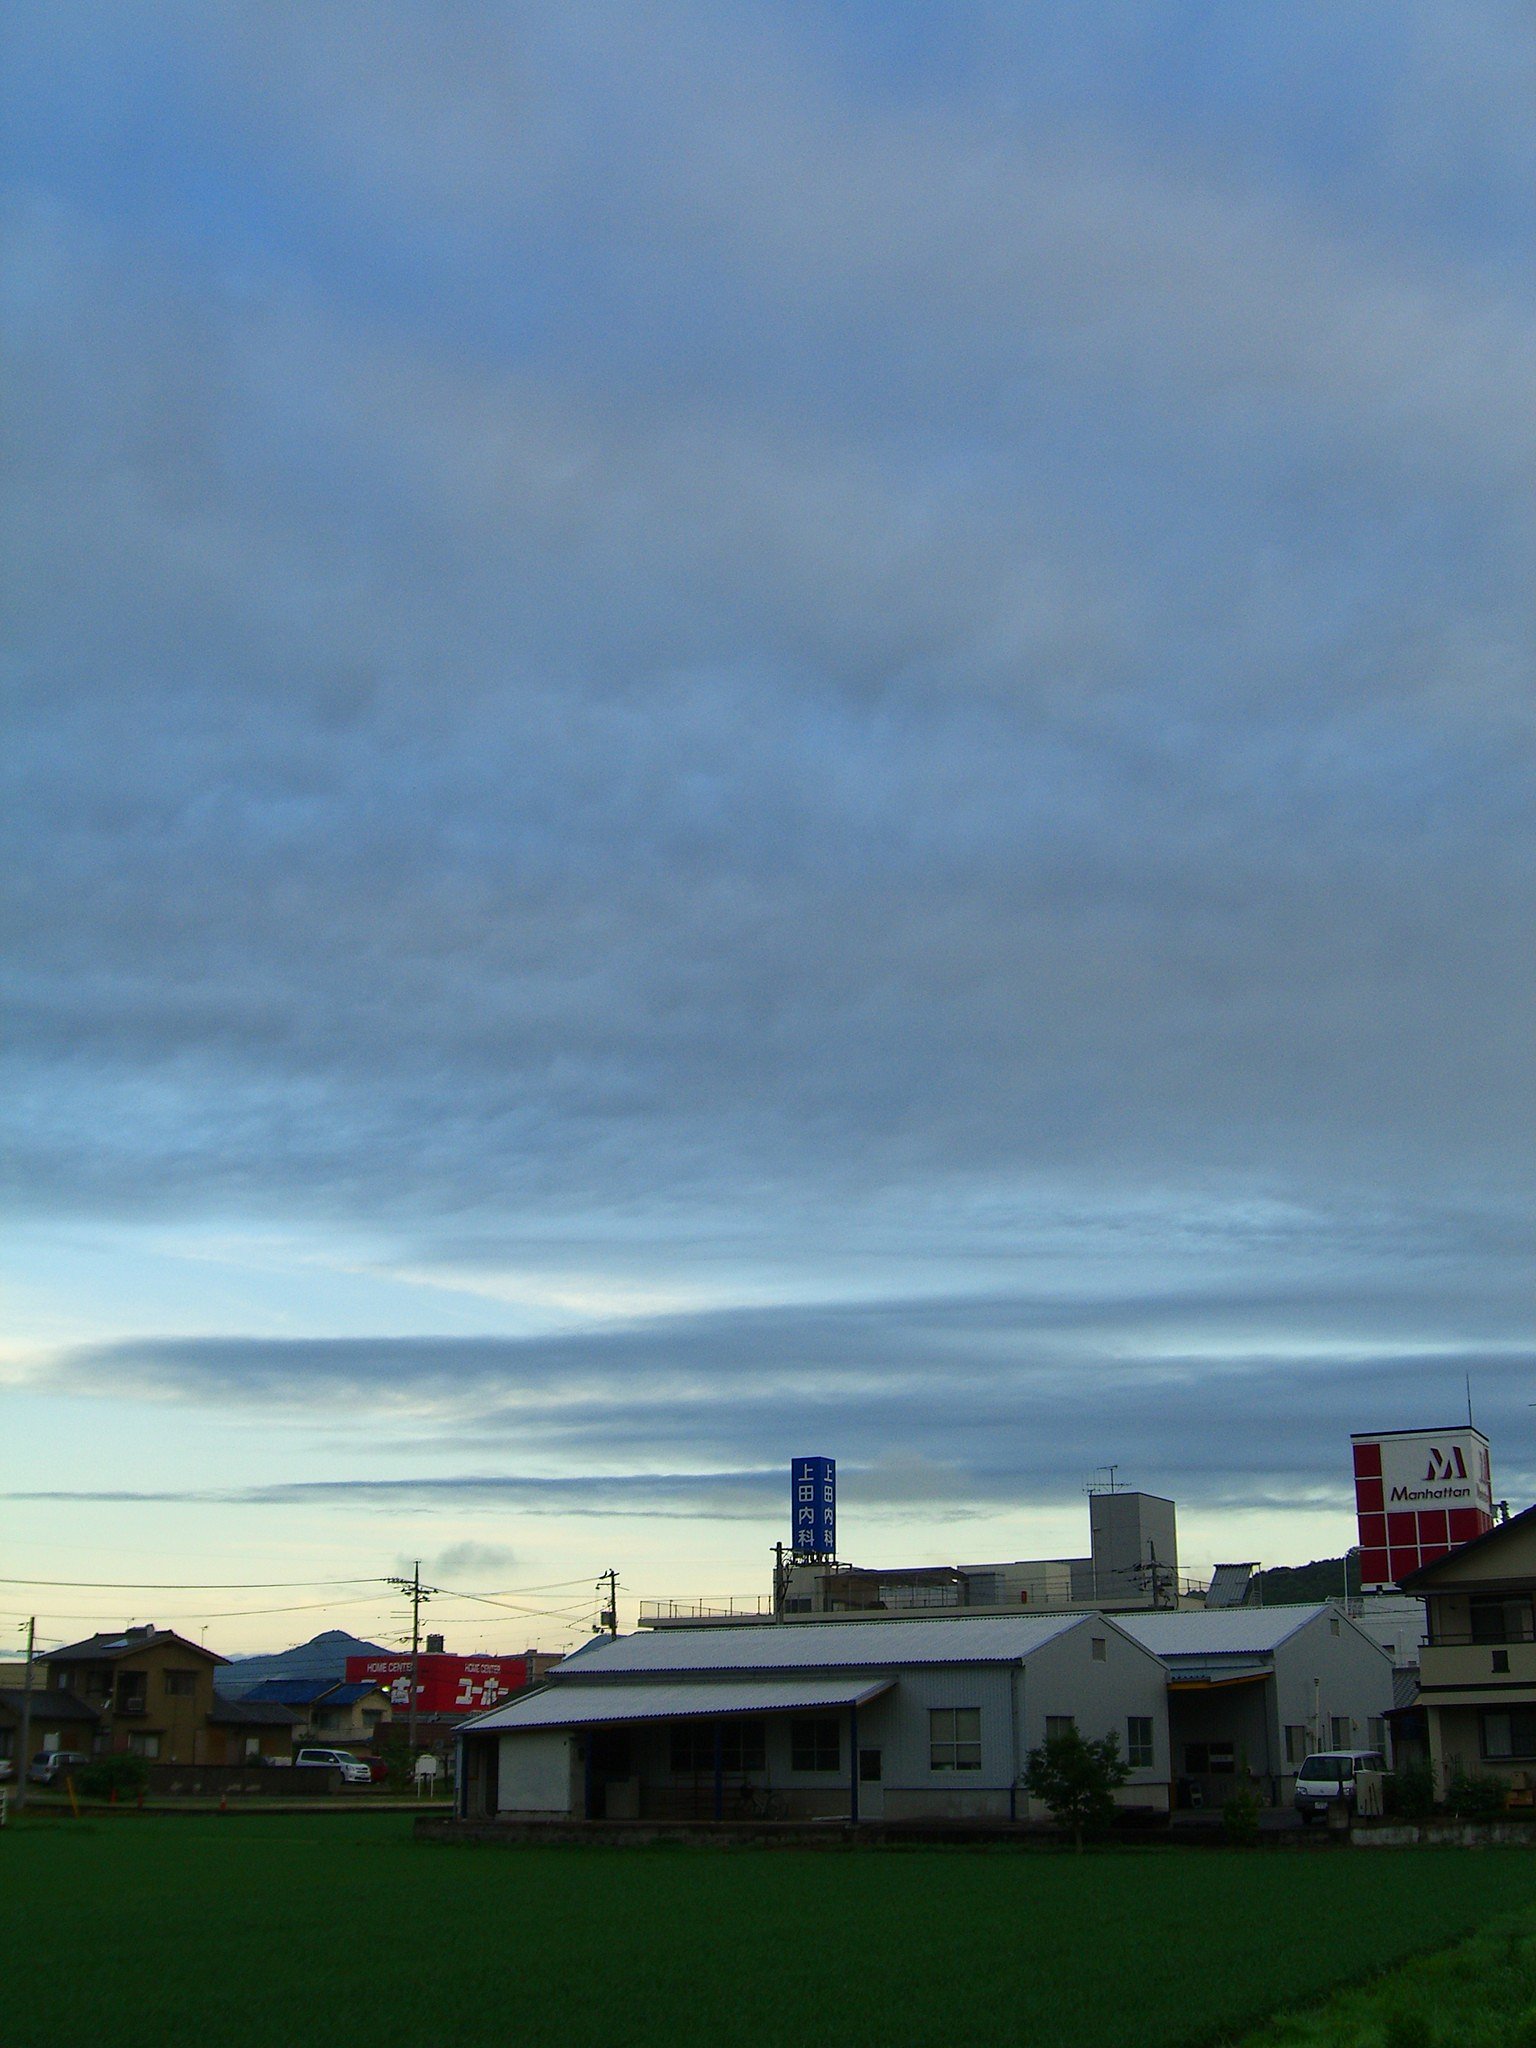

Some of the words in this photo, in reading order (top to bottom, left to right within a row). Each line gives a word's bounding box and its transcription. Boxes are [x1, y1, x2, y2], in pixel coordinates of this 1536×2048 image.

[1391, 1486, 1470, 1501] Manhattan
[798, 1463, 814, 1547] 上田内科
[824, 1464, 833, 1547] 上田内科
[366, 1662, 387, 1673] HOME
[464, 1663, 480, 1673] HOME
